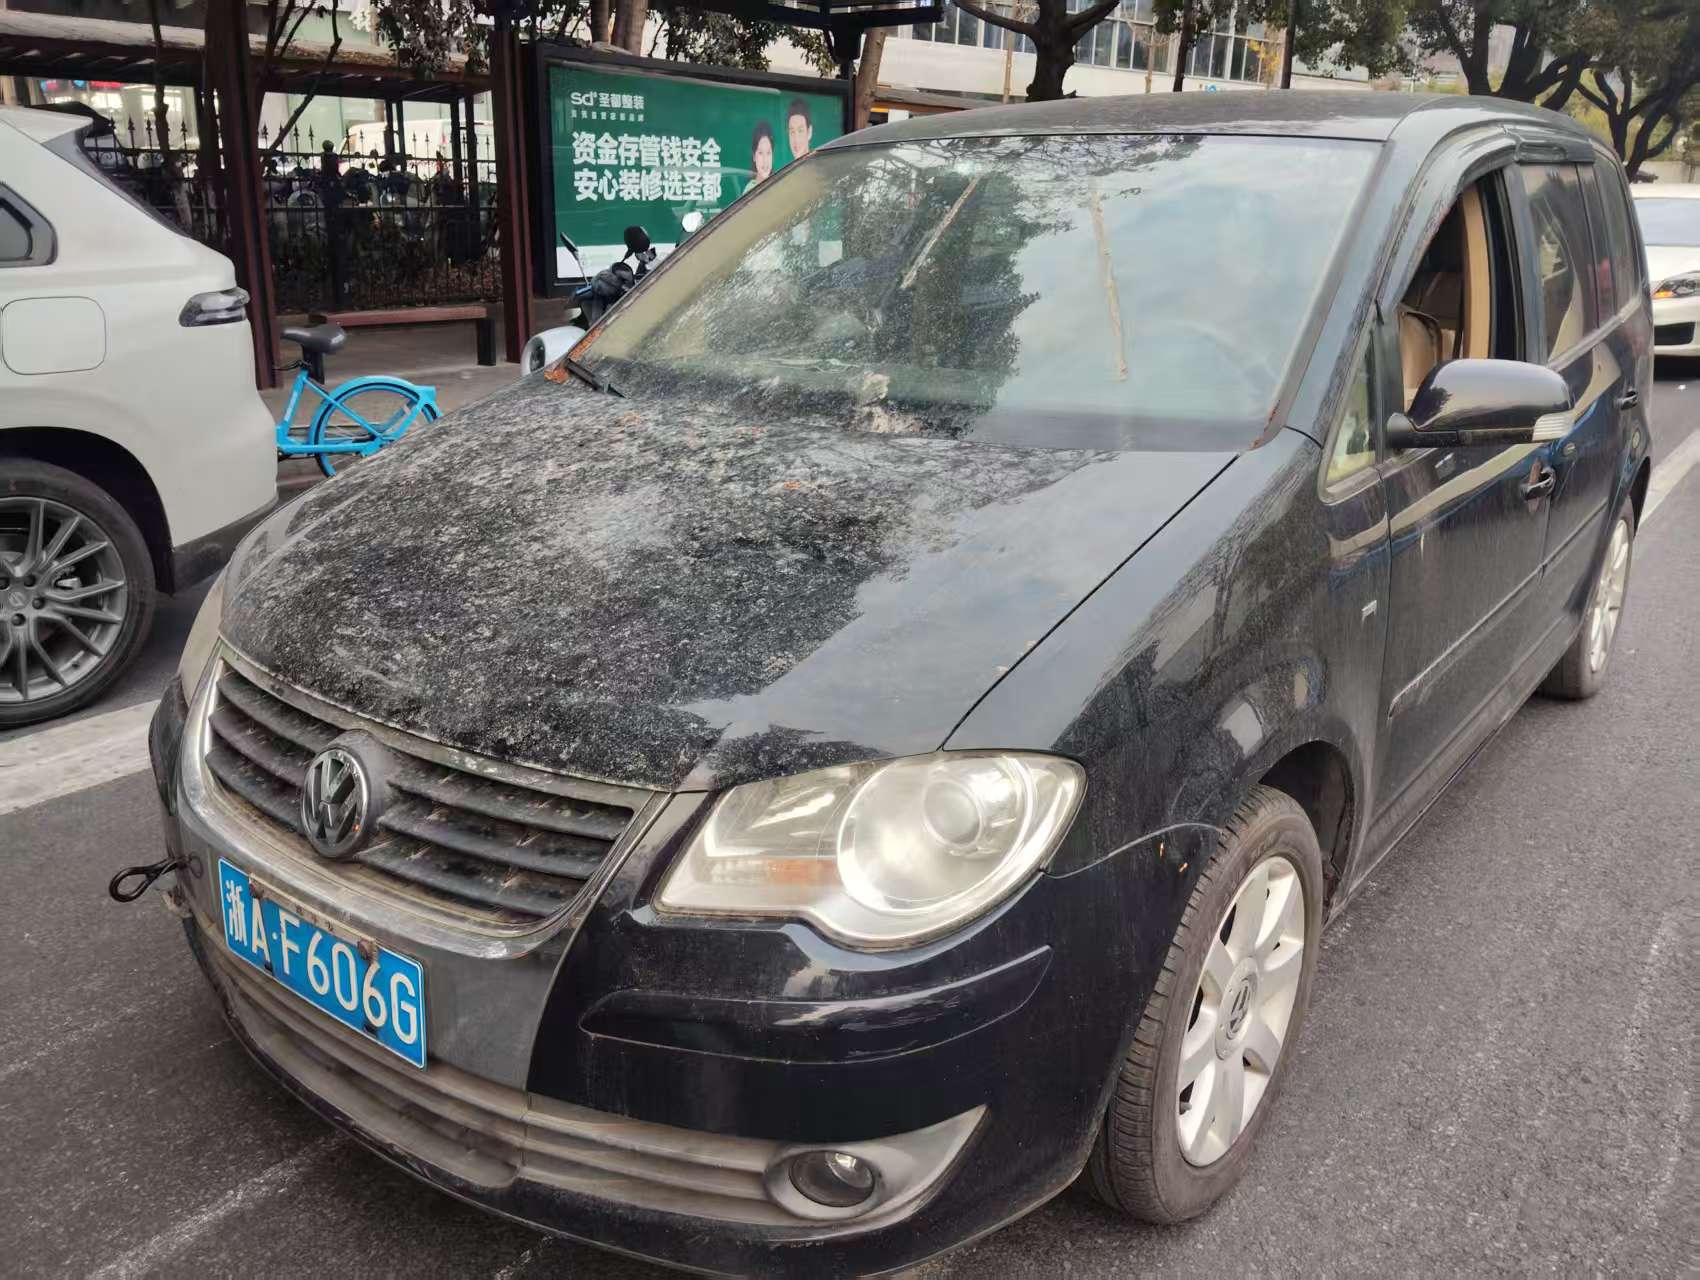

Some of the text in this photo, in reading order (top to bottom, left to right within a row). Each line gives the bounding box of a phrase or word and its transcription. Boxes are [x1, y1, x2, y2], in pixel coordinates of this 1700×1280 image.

[572, 131, 721, 167] 资金存管钱安全
[573, 168, 721, 201] 安心装修选圣都
